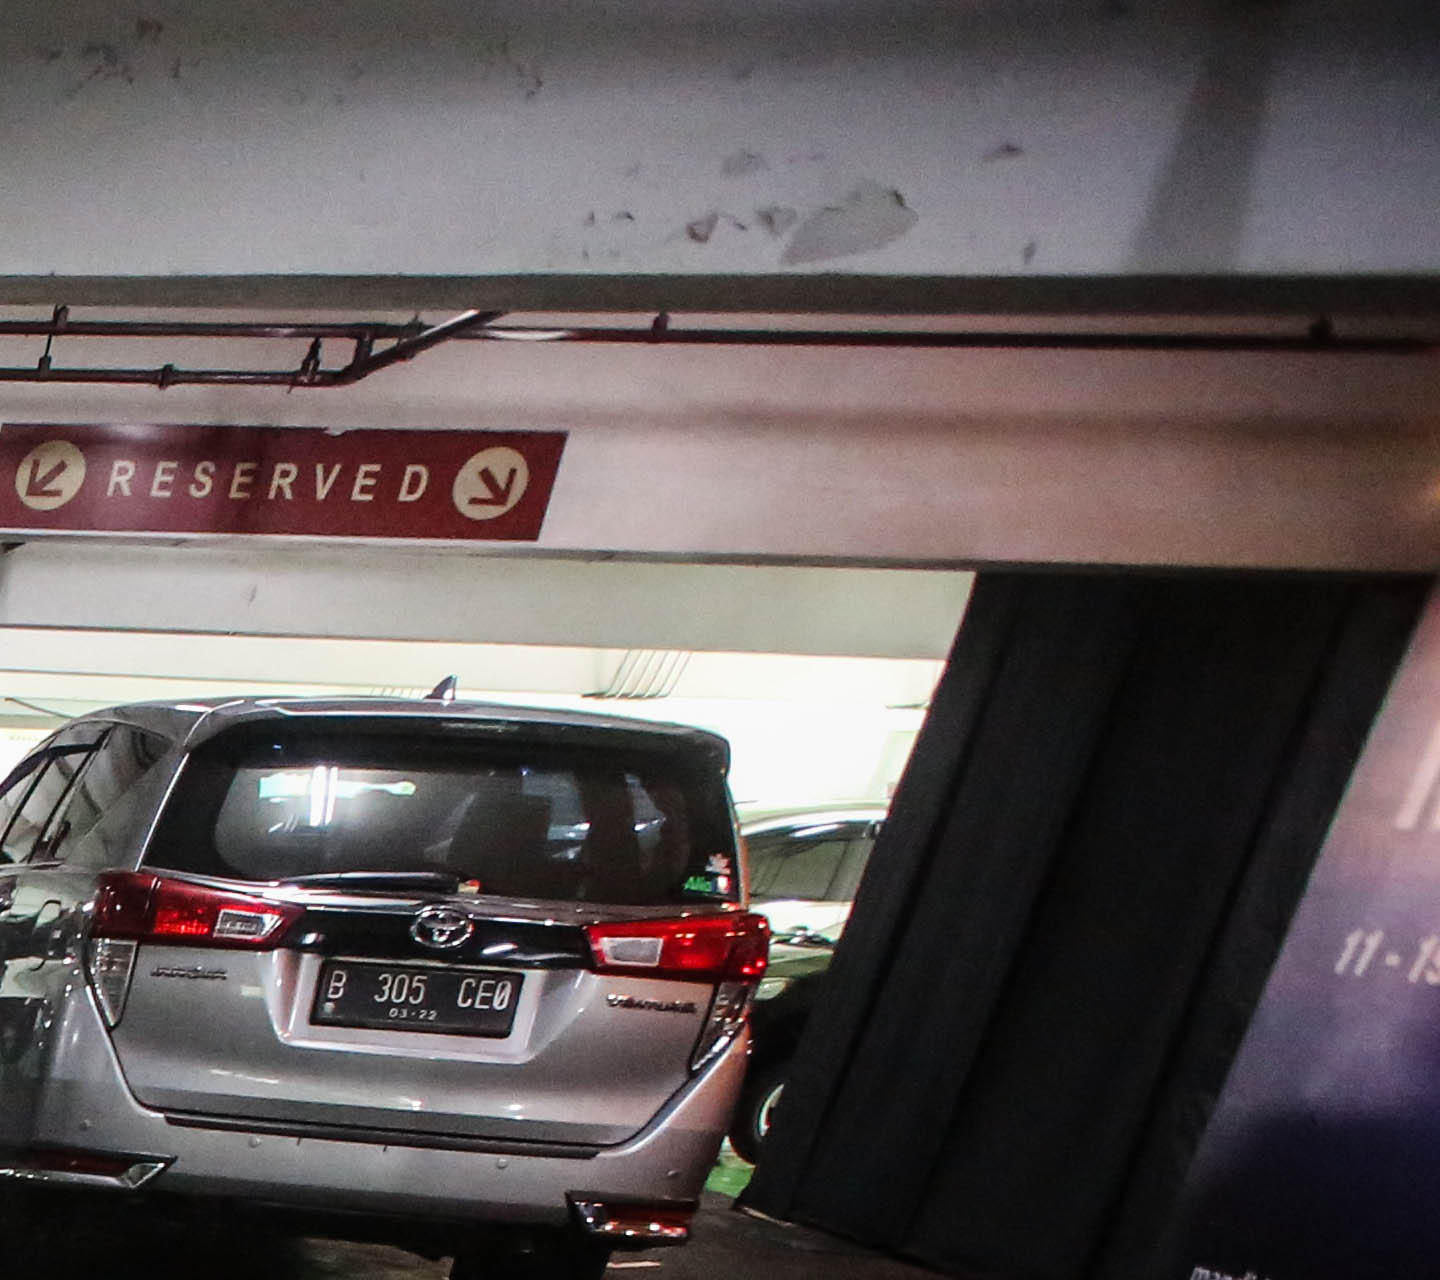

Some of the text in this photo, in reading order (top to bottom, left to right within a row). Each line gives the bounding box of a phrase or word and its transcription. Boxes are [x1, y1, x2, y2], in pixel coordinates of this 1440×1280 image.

[106, 460, 430, 502] RESERVED
[1334, 928, 1384, 976] 11
[327, 969, 347, 999] B
[373, 973, 428, 1005] 305
